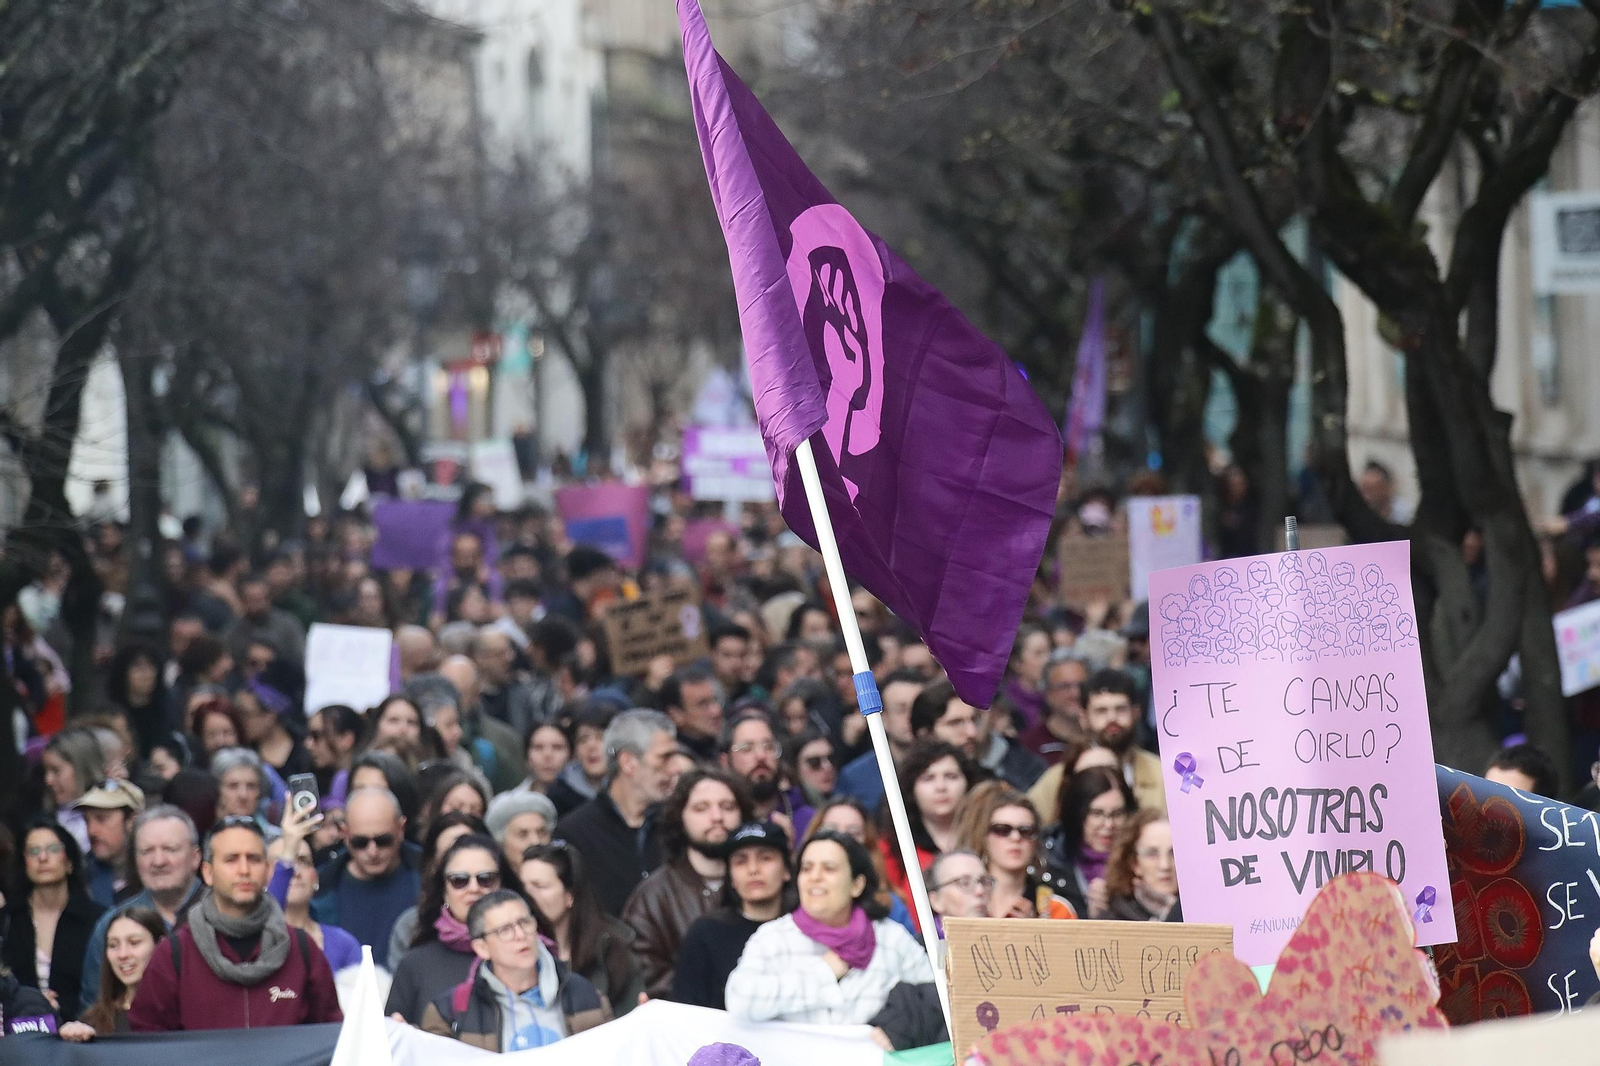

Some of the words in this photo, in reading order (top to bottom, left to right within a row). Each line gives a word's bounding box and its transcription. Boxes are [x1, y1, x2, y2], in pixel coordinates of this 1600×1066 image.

[1283, 672, 1399, 716] CANSAS
[1217, 739, 1261, 773] DE
[1294, 723, 1402, 764] OIRLO?
[1204, 783, 1389, 845] NOSOTRAS
[1219, 854, 1262, 888] DE
[1546, 881, 1585, 930] SE
[971, 934, 1050, 993] NIN
[1074, 939, 1124, 992] UN
[1140, 944, 1223, 995] PA
